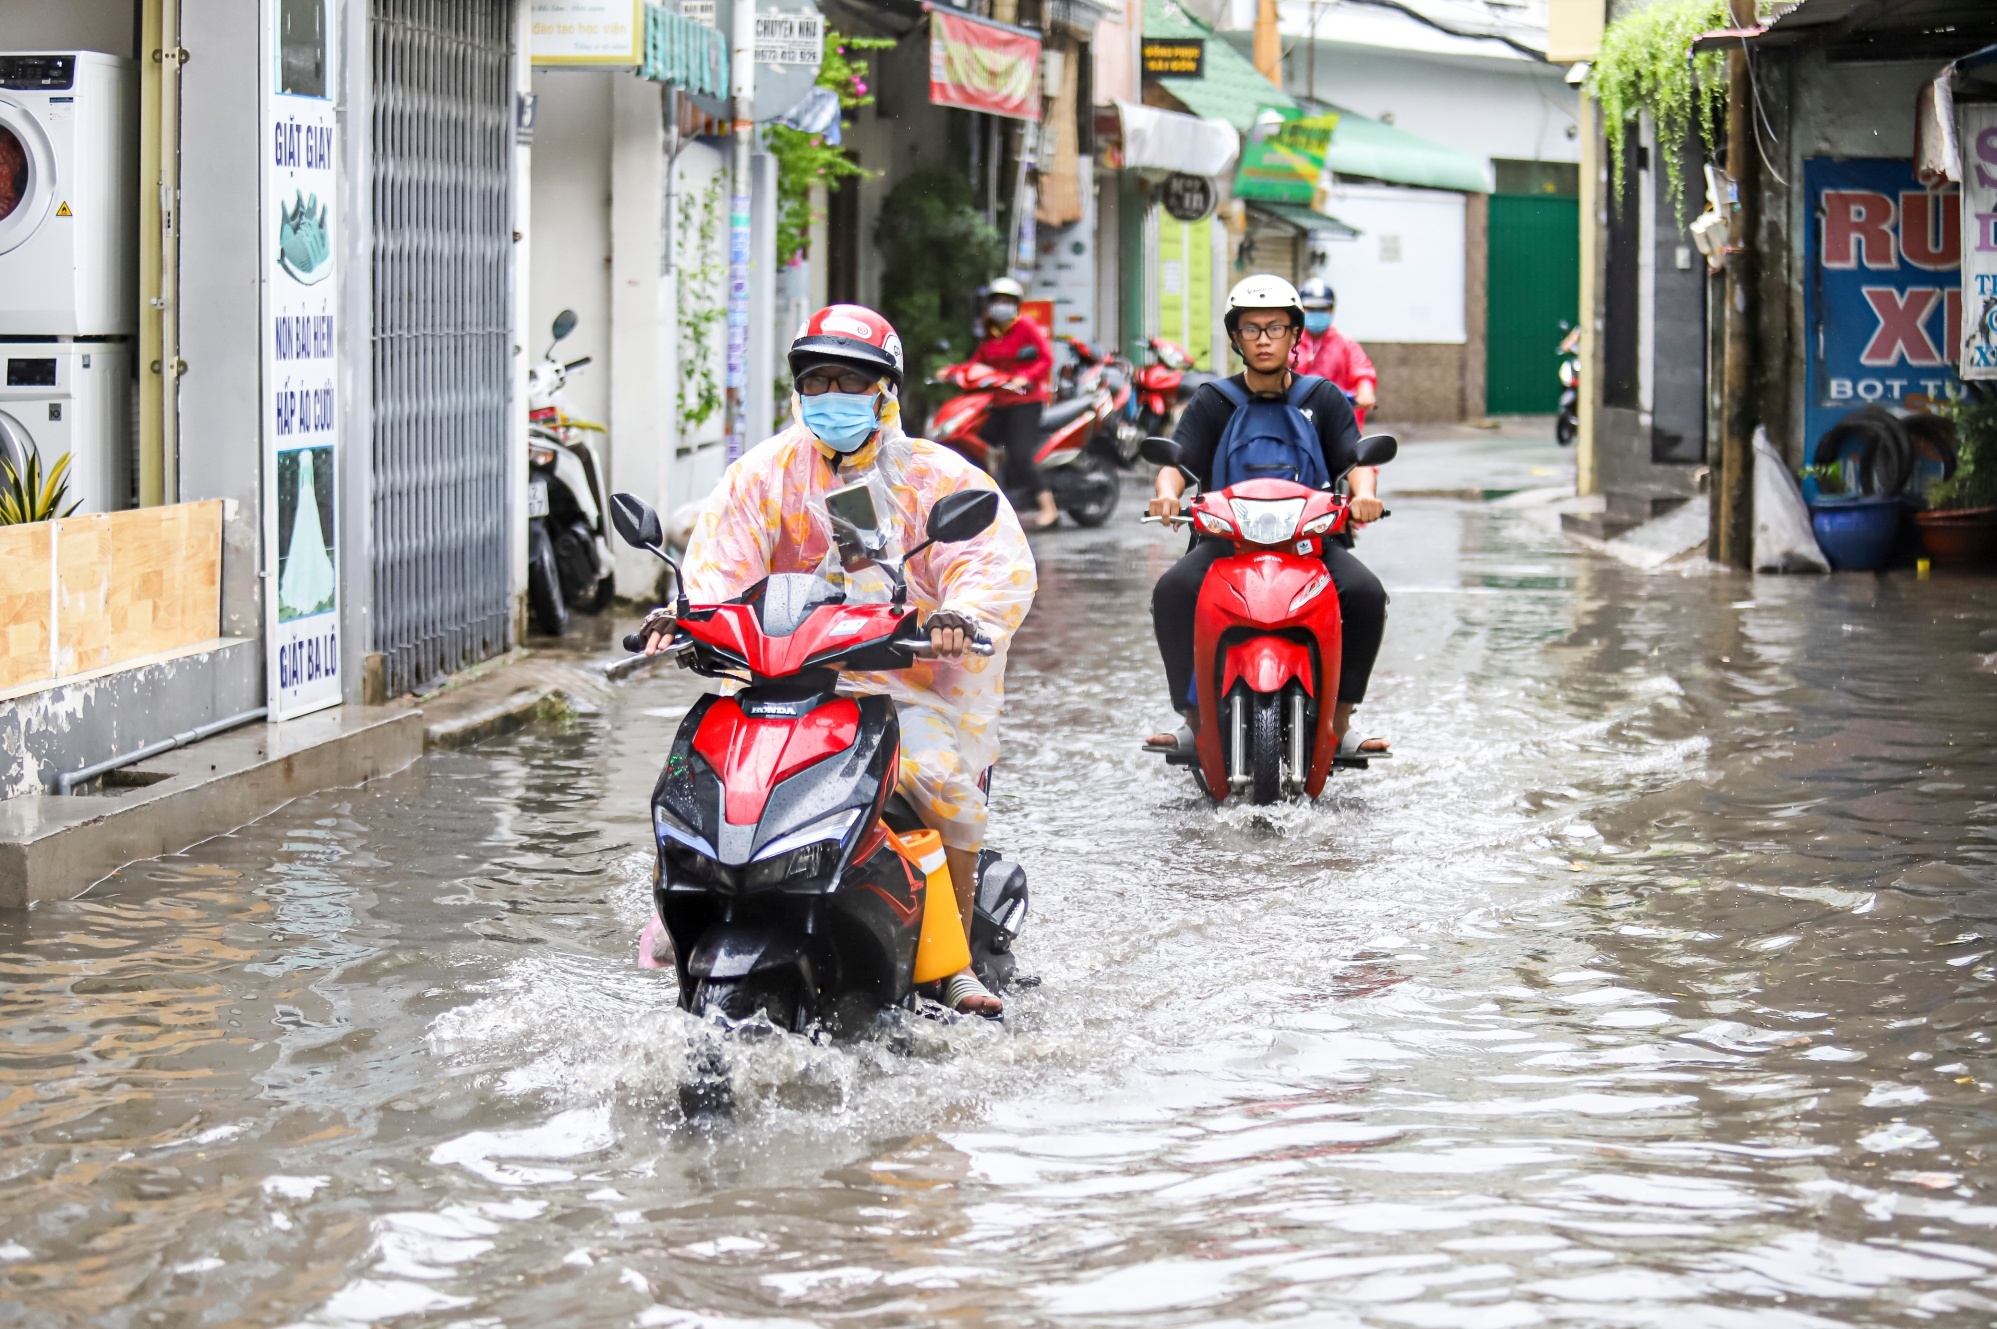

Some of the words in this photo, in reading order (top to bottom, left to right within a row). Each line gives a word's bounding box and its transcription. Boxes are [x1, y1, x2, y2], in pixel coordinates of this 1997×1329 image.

[275, 114, 302, 178] GIẶT
[306, 116, 333, 170] GIÀY
[275, 305, 293, 360] NÓN
[277, 375, 295, 436] HẤP
[299, 379, 311, 433] ÁO
[279, 632, 305, 697] GIẶT
[308, 636, 321, 682] BA
[751, 706, 797, 715] HONDA
